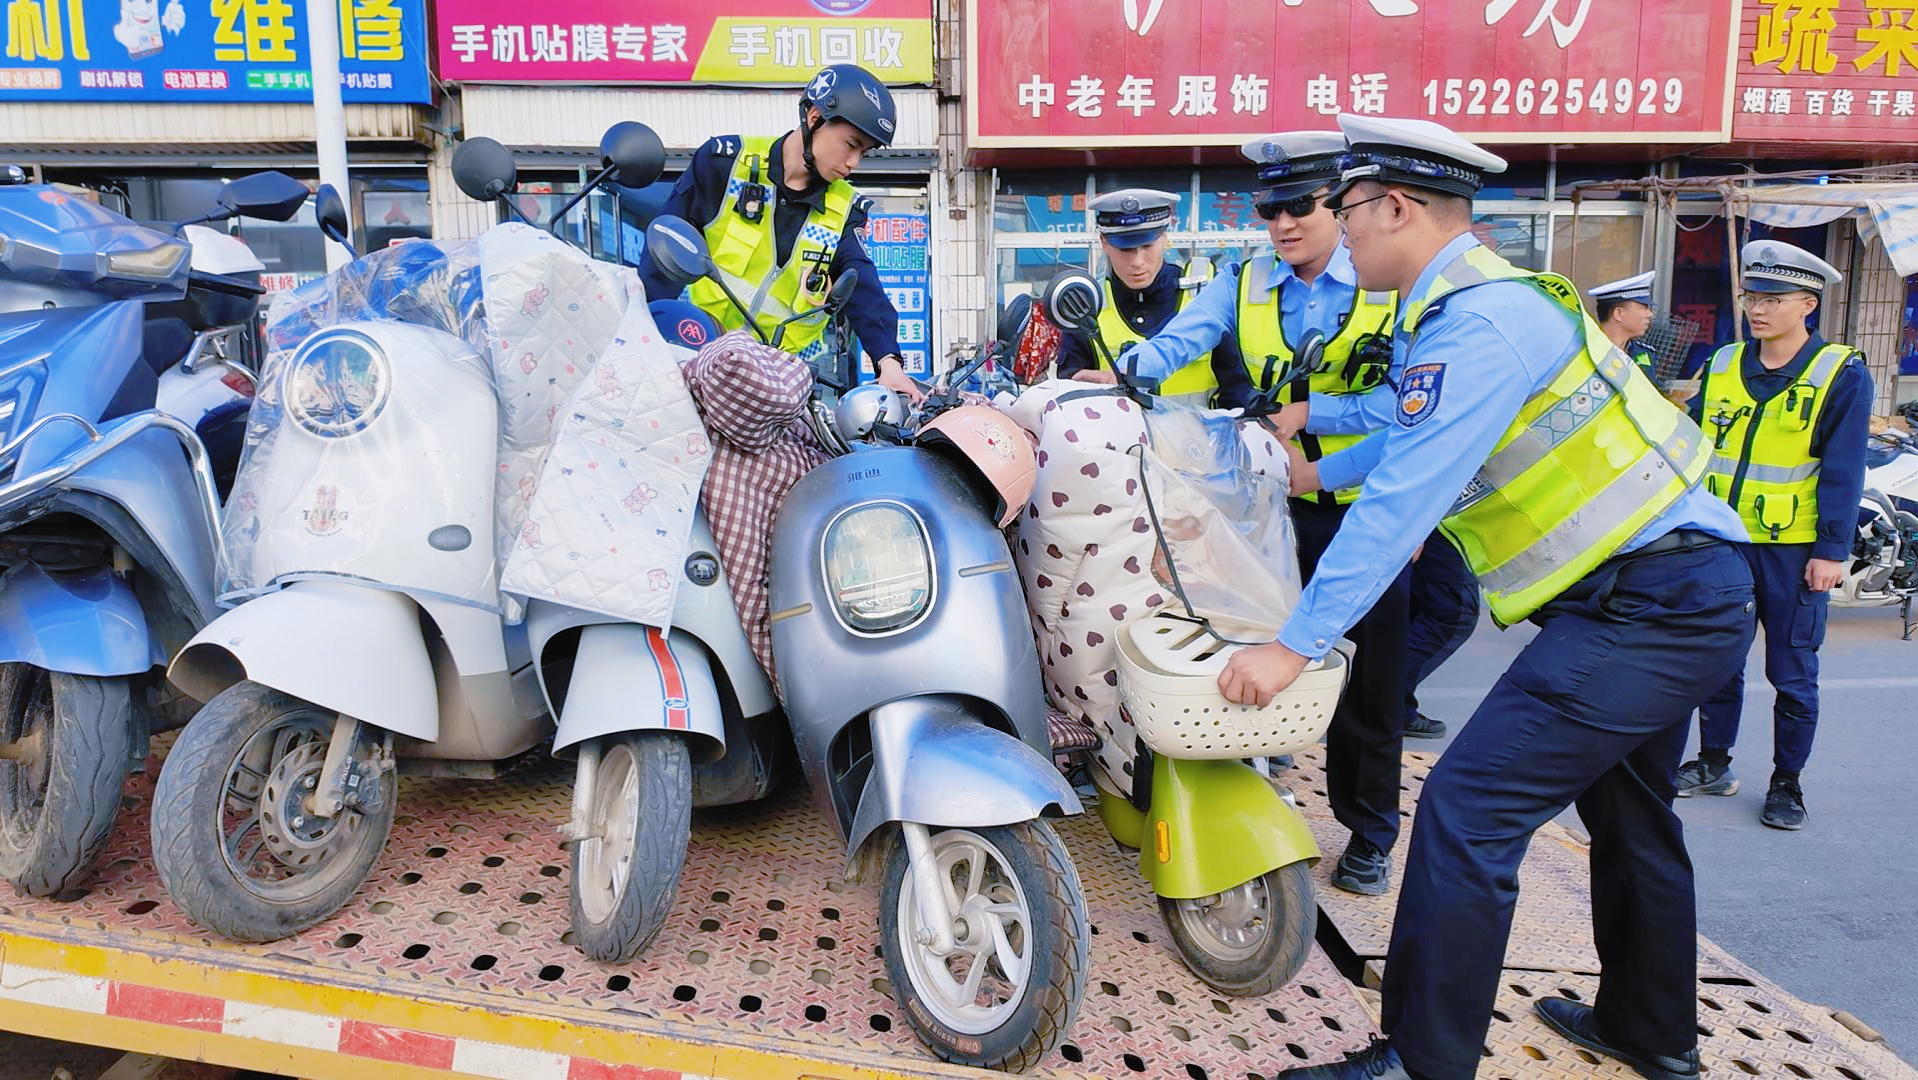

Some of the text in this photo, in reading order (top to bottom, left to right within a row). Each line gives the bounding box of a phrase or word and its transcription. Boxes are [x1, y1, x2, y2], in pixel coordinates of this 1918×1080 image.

[451, 24, 688, 64] 手机贴膜专家
[728, 26, 904, 69] 手机回收
[81, 71, 144, 88] 刷机解锁
[164, 71, 227, 88] 电池更换
[248, 71, 310, 89] 二手手机
[1306, 72, 1389, 115] 电话
[1422, 77, 1684, 115] 15226254929
[1743, 88, 1915, 116] 烟酒 百货 干果
